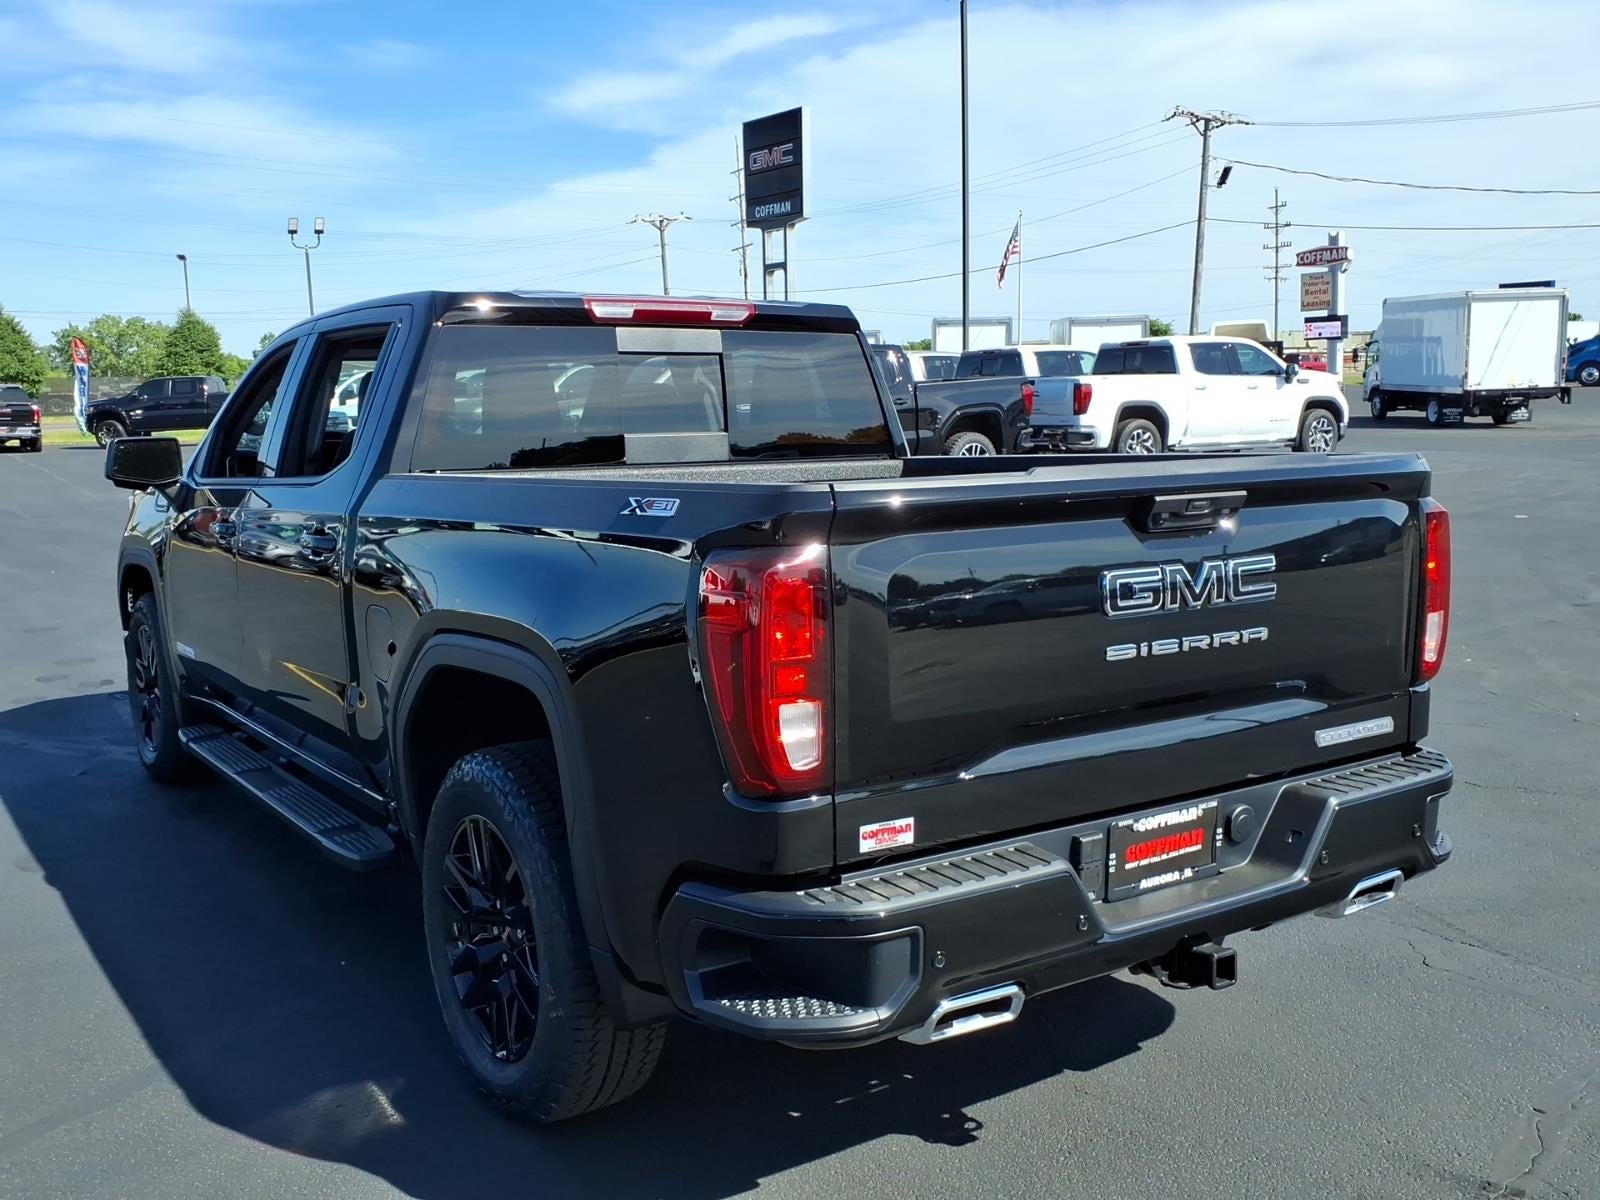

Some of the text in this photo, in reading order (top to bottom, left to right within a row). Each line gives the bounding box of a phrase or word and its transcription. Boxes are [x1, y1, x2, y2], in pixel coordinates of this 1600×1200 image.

[749, 143, 794, 171] GMC
[754, 201, 792, 218] COFFMAN
[1298, 248, 1346, 264] COFFMAN
[1304, 287, 1329, 296] Rental
[1302, 300, 1331, 308] Leasing
[1099, 553, 1277, 618] GMC
[1105, 626, 1269, 662] SIERRA
[1138, 806, 1198, 831] COFFMAN
[861, 824, 911, 840] COFFMAN
[1126, 829, 1204, 862] COFFMAN
[1139, 871, 1180, 889] AURORA
